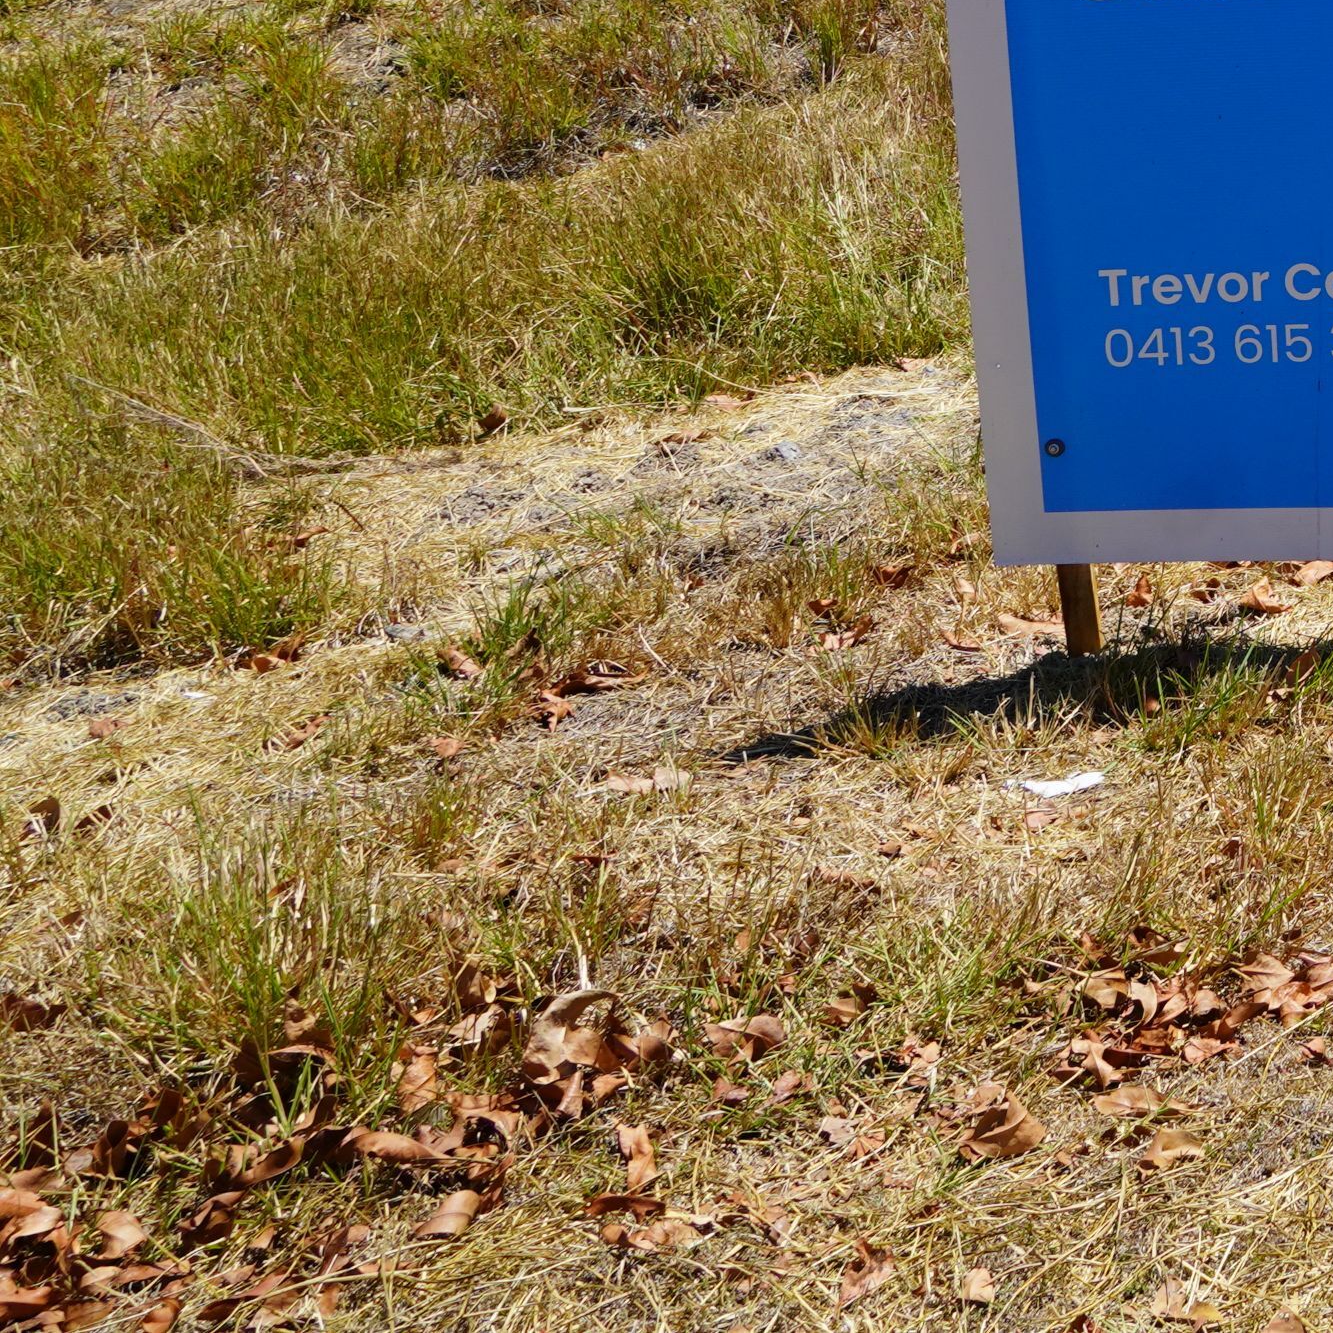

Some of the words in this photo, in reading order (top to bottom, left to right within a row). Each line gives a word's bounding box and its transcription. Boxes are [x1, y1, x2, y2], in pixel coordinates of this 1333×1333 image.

[1099, 270, 1269, 306] Trevor
[1105, 326, 1215, 367] 0413
[1235, 324, 1312, 363] 615
